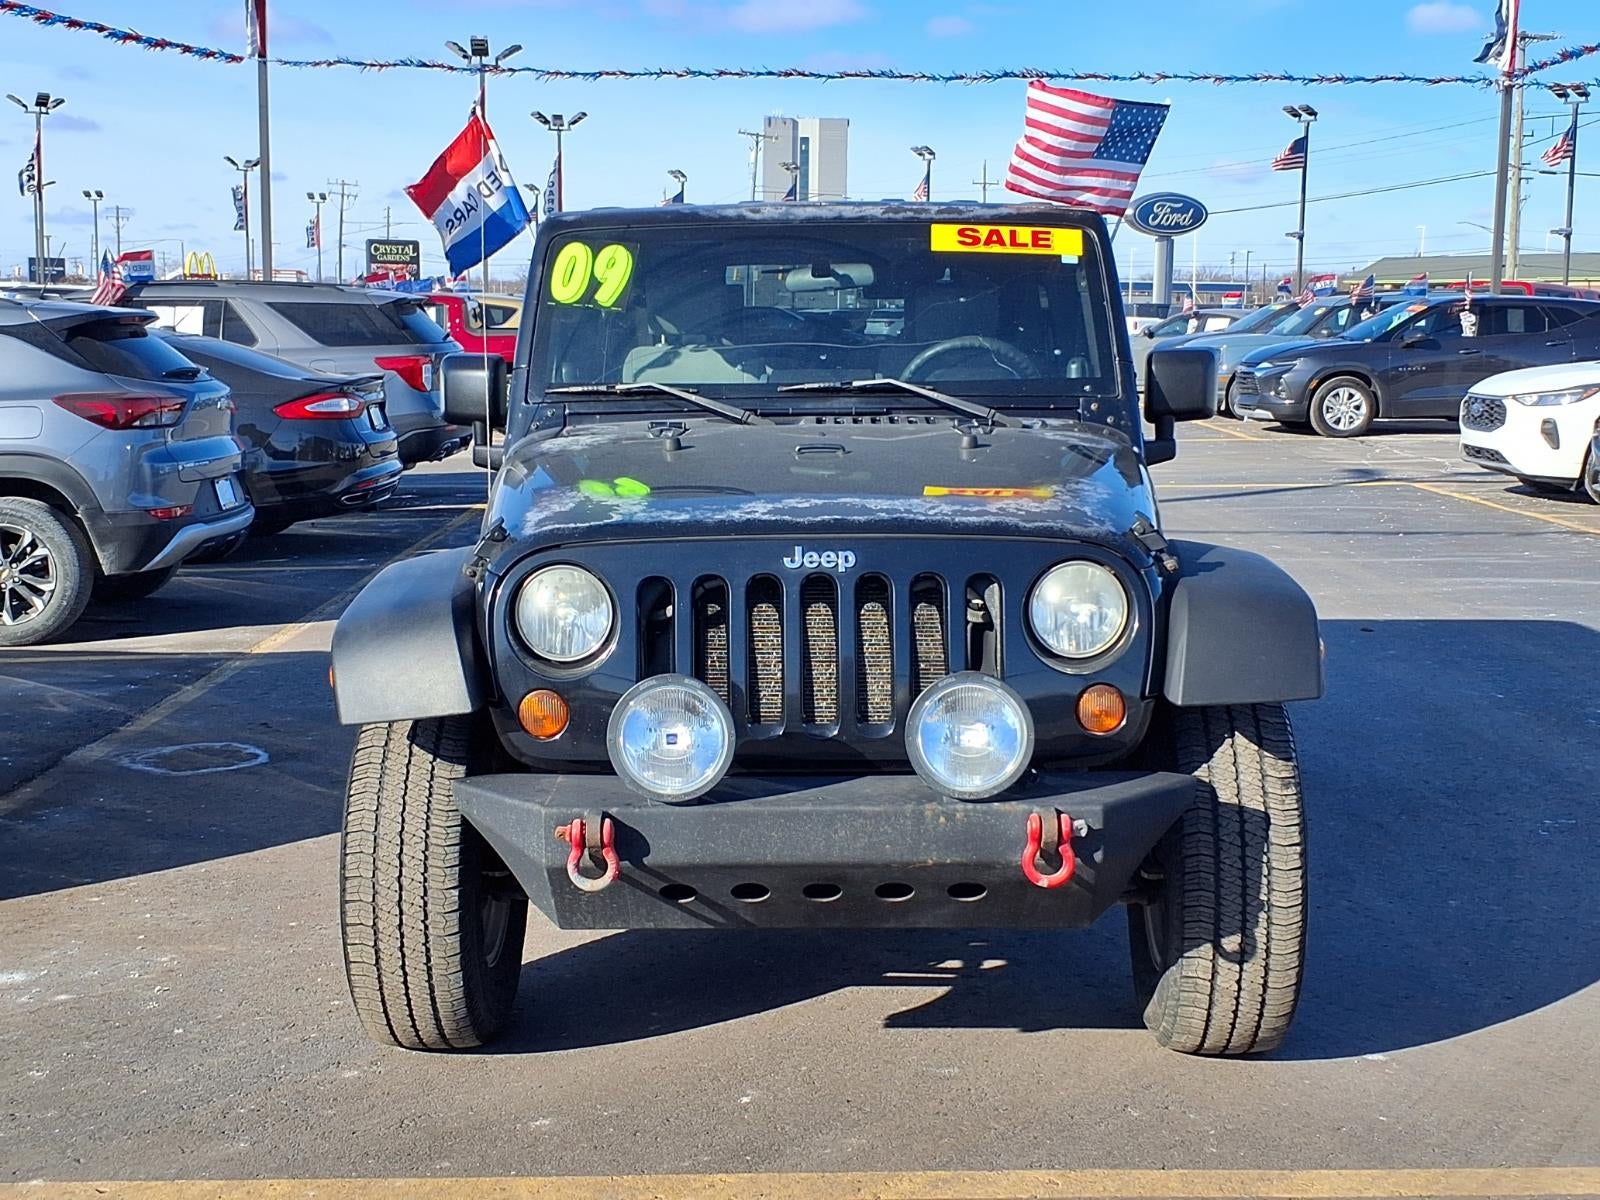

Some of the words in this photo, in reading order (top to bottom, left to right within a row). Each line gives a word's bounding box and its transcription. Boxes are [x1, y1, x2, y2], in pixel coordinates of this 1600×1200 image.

[1148, 201, 1194, 227] Ford
[370, 243, 418, 257] CRYSTAL
[956, 227, 1054, 249] SALE
[376, 253, 410, 262] GARDENS
[550, 241, 633, 307] 09
[783, 546, 856, 572] Jeep
